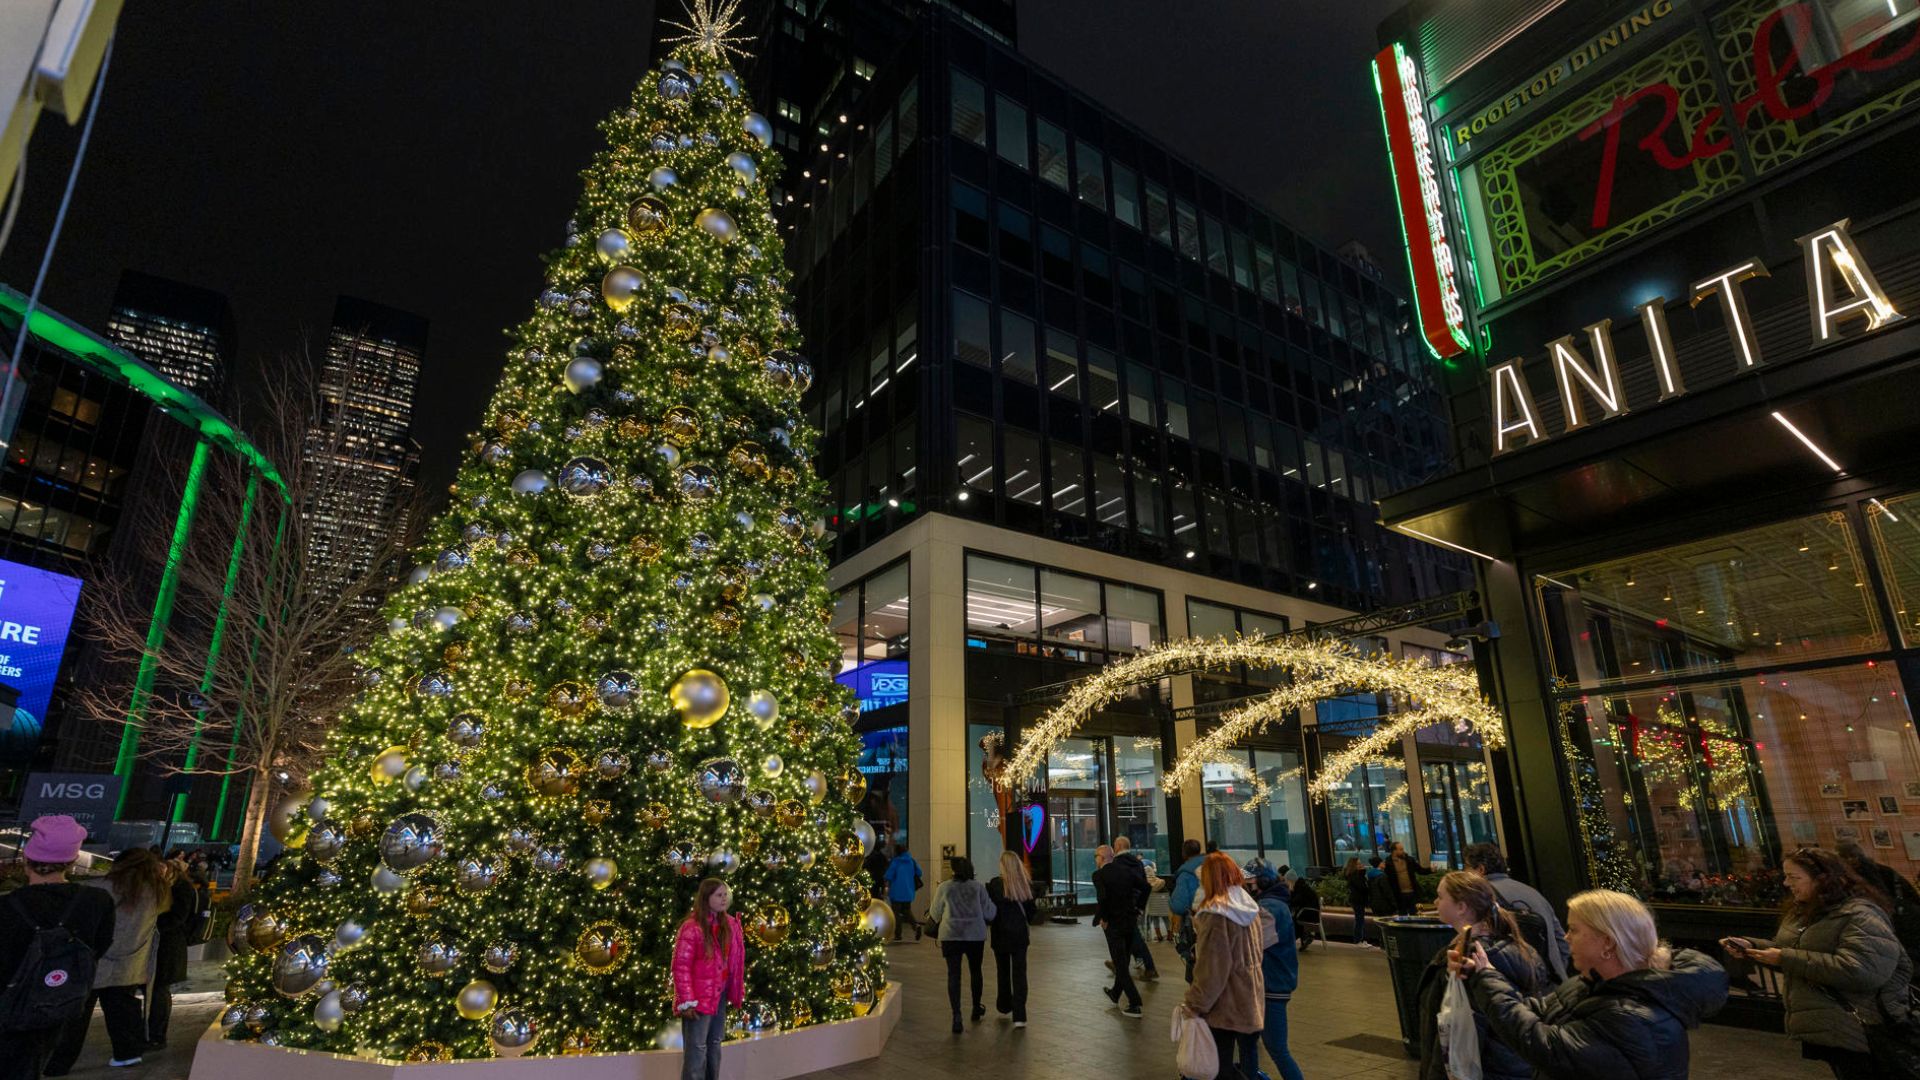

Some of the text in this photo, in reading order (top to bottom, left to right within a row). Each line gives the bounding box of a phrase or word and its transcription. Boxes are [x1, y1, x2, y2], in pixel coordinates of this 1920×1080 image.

[1456, 0, 1673, 145] ROOFTOP DINING
[1487, 217, 1907, 459] ANITA
[0, 621, 41, 645] RE
[40, 782, 105, 799] MSG
